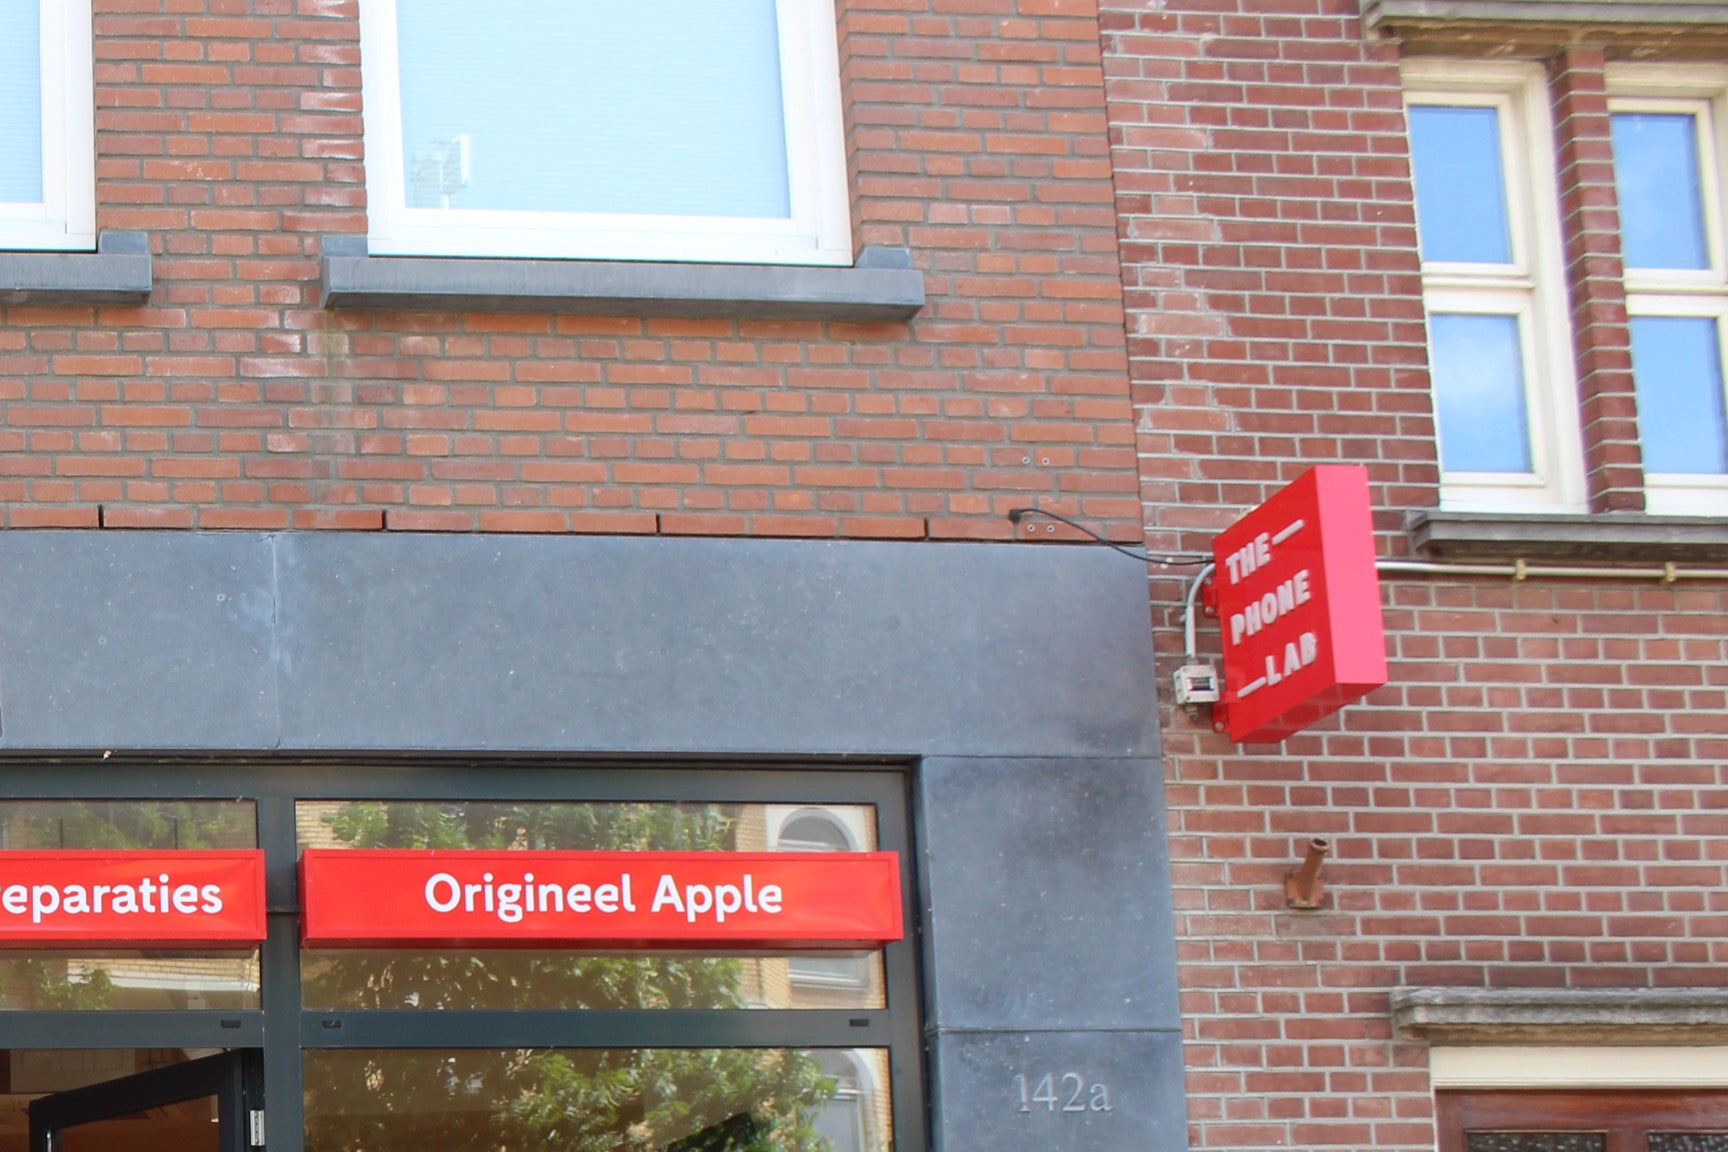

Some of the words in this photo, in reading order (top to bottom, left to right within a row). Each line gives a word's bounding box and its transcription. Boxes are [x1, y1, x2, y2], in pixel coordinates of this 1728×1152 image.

[1226, 531, 1271, 585] THE
[1230, 569, 1311, 645] PHONE
[1265, 632, 1317, 686] LAB
[425, 873, 636, 923] Origineel
[652, 874, 784, 923] Apple
[1015, 1071, 1113, 1112] 142a
